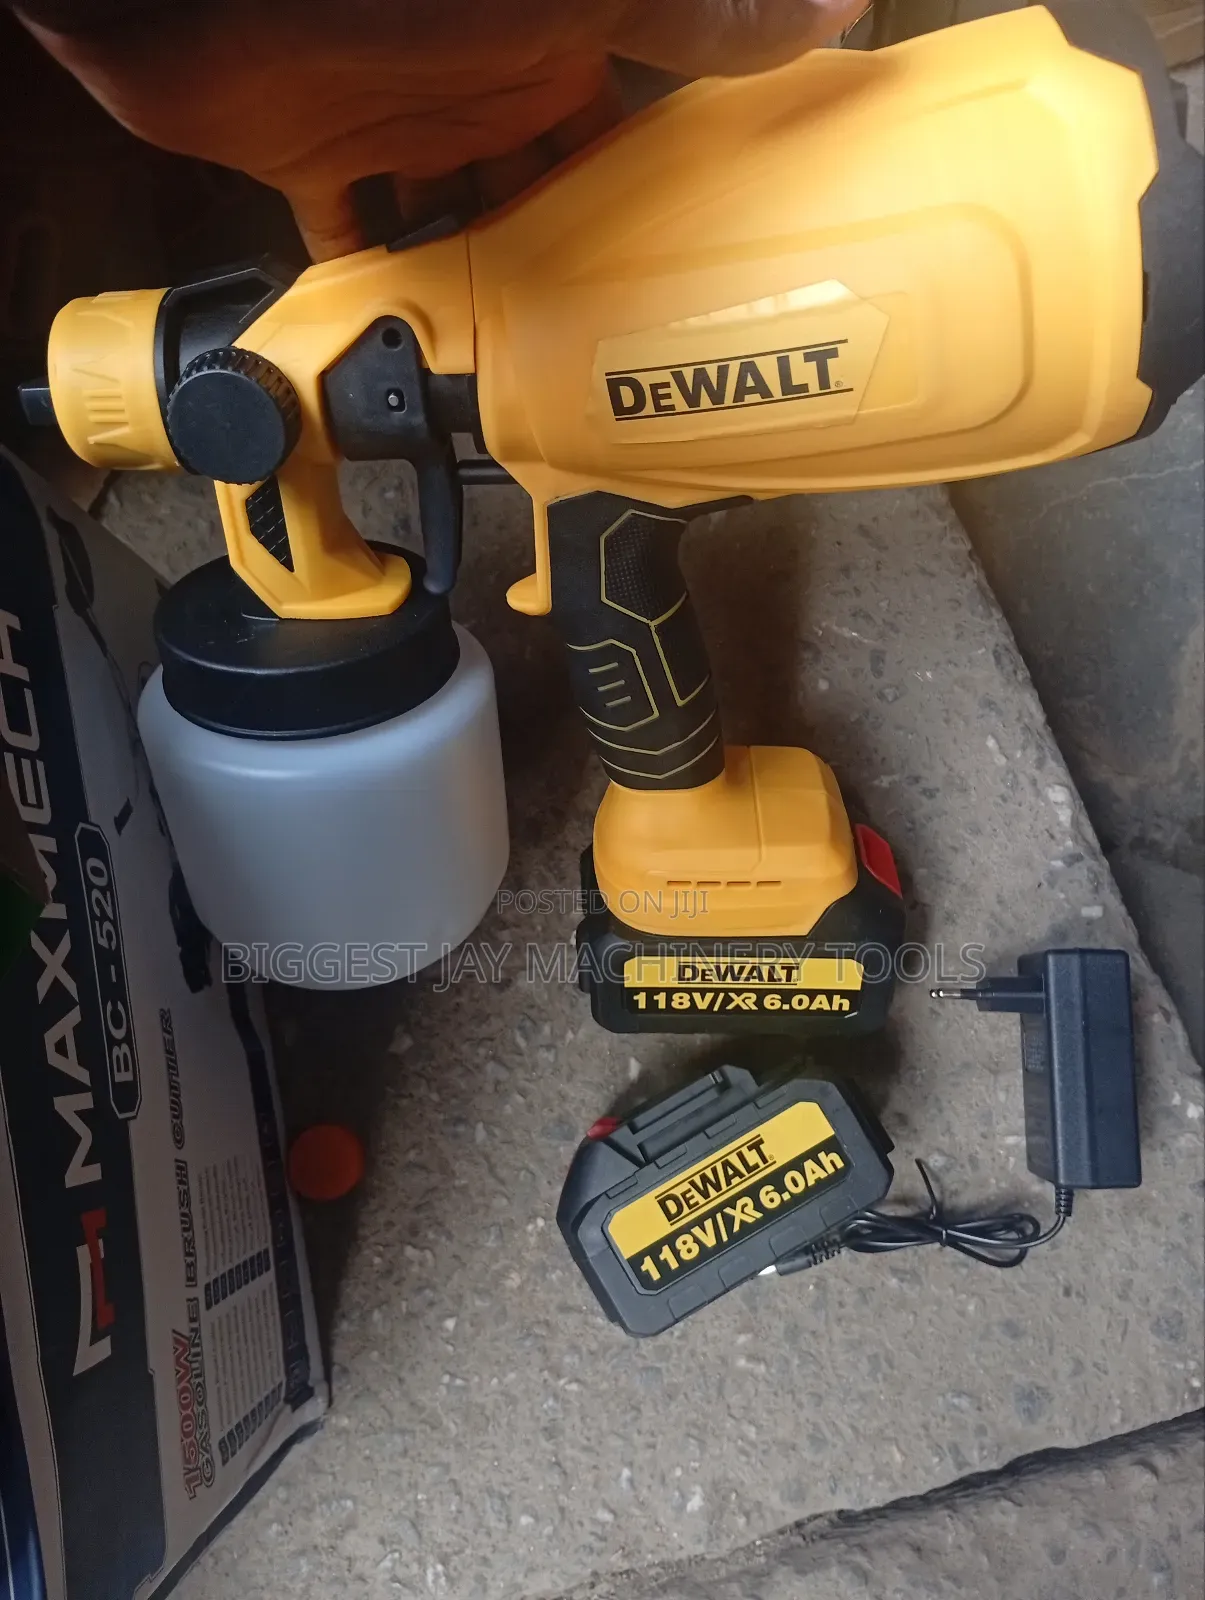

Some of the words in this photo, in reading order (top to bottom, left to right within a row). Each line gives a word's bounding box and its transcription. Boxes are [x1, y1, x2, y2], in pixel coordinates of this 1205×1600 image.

[606, 346, 839, 417] DEWALT
[86, 856, 118, 948] 520
[677, 963, 799, 984] DEWALT
[766, 993, 851, 1012] 6.0Ah
[107, 1000, 135, 1084] BC
[158, 1006, 186, 1150] CUTTER
[656, 1137, 769, 1223] DEWALT
[758, 1149, 845, 1210] 6.0Ah
[171, 1158, 199, 1288] BRUSH
[171, 1328, 201, 1500] 1500W
[185, 1297, 216, 1489] GASOLINE
